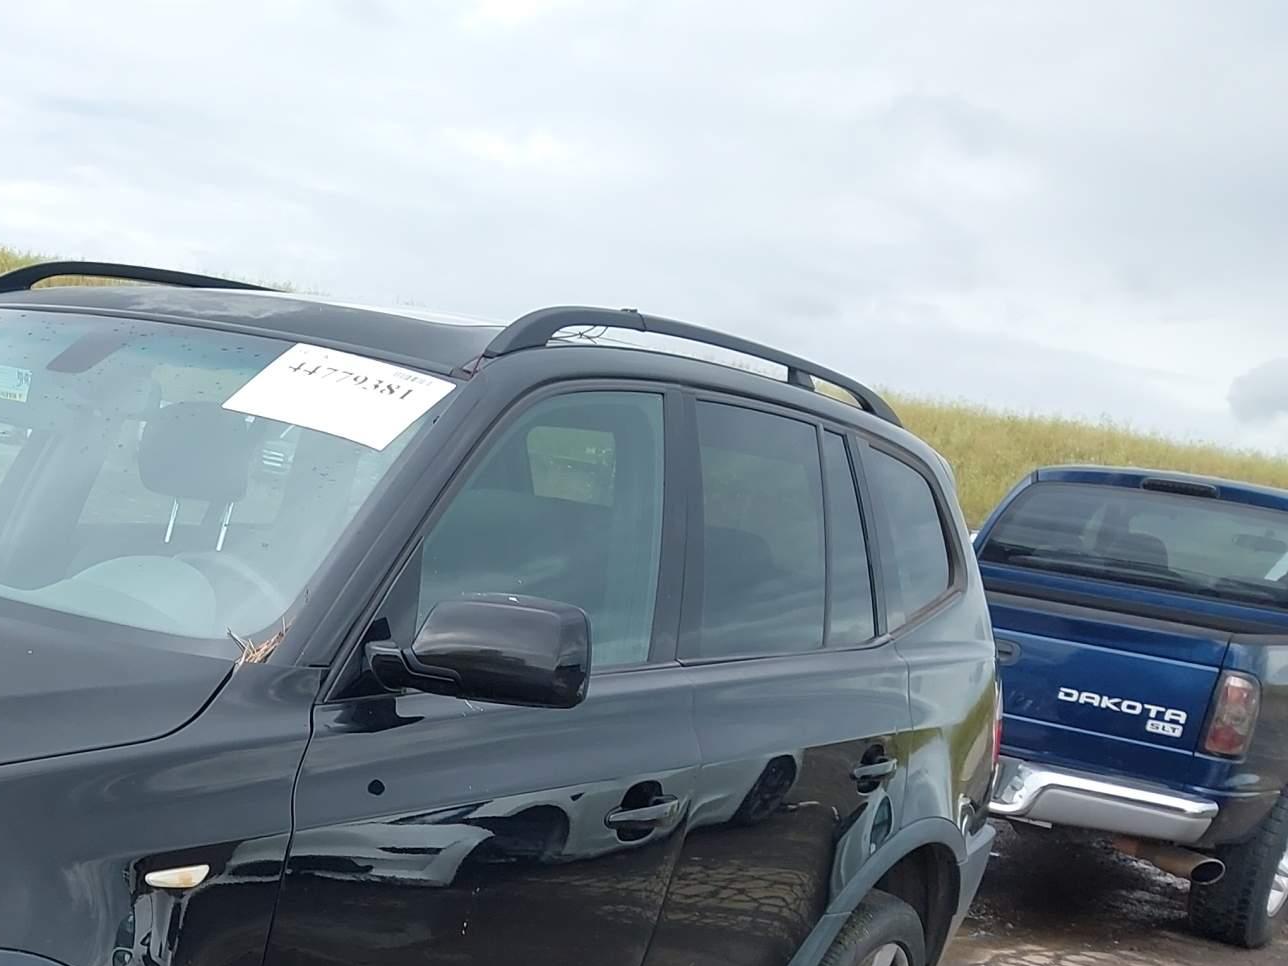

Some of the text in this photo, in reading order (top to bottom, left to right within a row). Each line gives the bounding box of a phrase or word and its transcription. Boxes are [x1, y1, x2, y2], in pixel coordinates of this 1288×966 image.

[288, 360, 414, 401] 44779381
[1057, 686, 1188, 725] DAKOTA
[1148, 720, 1181, 736] SLT
